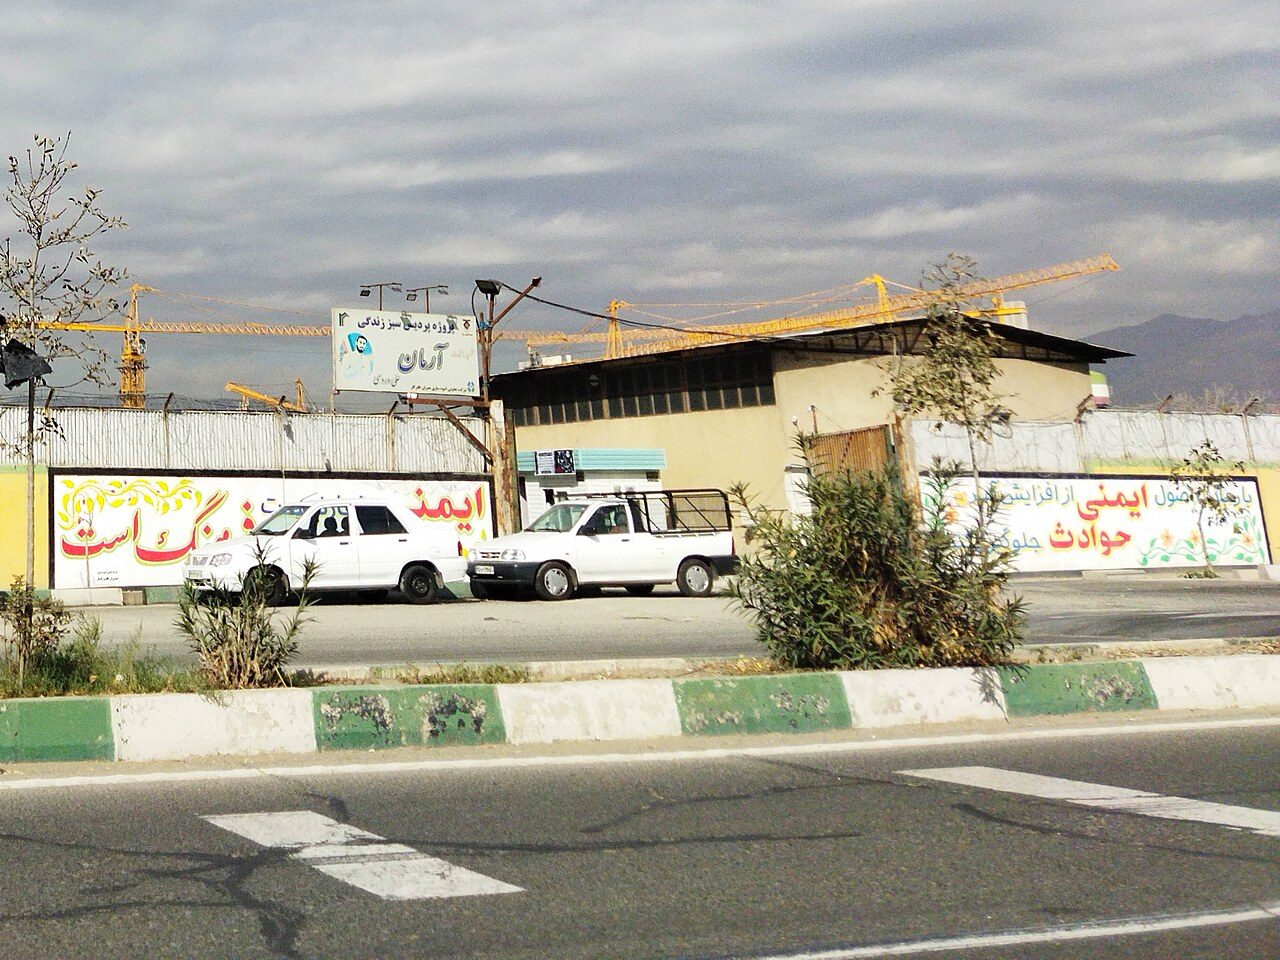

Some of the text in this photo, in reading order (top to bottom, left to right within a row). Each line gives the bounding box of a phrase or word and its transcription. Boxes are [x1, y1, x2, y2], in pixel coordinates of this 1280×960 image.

[357, 316, 386, 331] زندگی
[387, 319, 402, 331] سبز
[396, 342, 450, 375] آرمان
[1002, 482, 1058, 507] افزایش
[1061, 485, 1074, 506] از
[1077, 483, 1148, 522] ایمنی
[61, 508, 140, 559] است
[1049, 521, 1131, 556] حوادث
